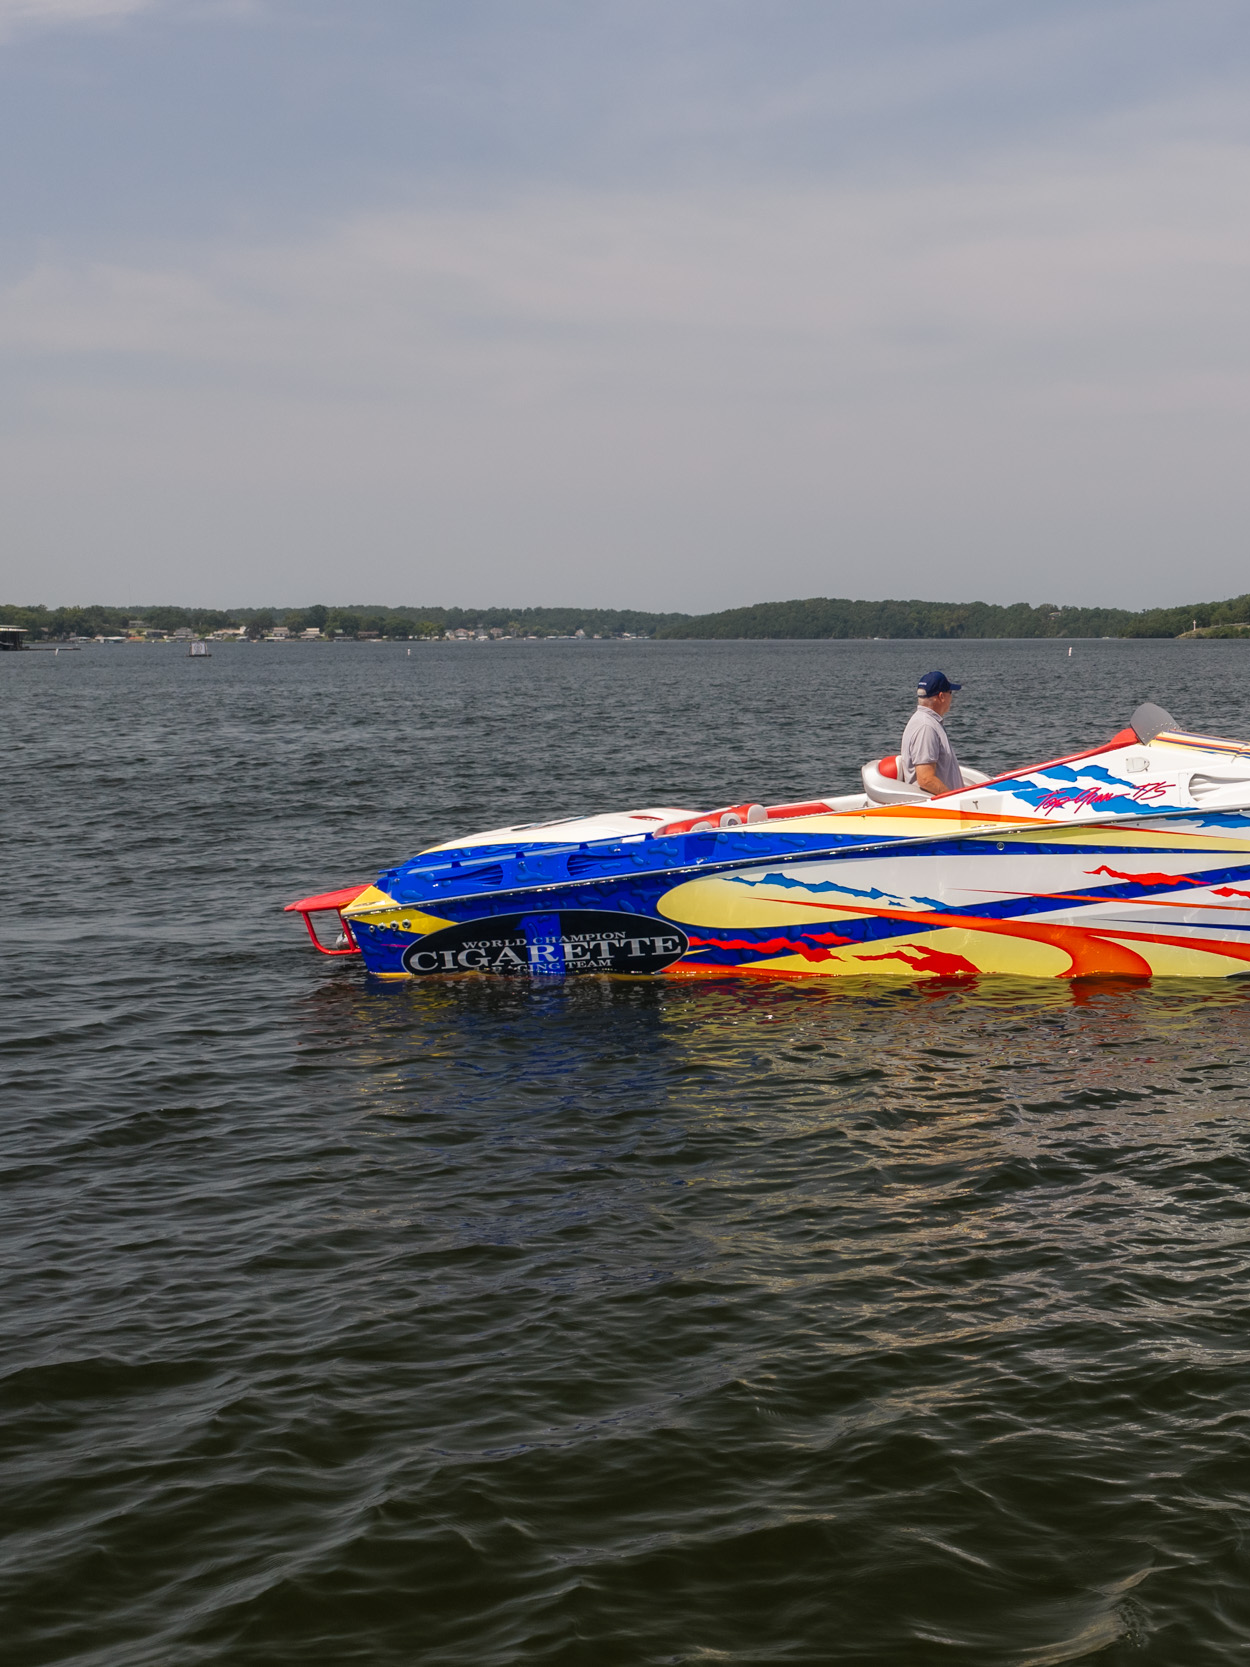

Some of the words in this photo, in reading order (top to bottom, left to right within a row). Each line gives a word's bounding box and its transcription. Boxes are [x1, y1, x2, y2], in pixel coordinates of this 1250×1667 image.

[1034, 790, 1070, 816] Top
[461, 938, 527, 949] WORLD
[532, 931, 627, 945] CHAMPION
[409, 935, 682, 971] CIGARETTE
[565, 959, 612, 969] TEAM
